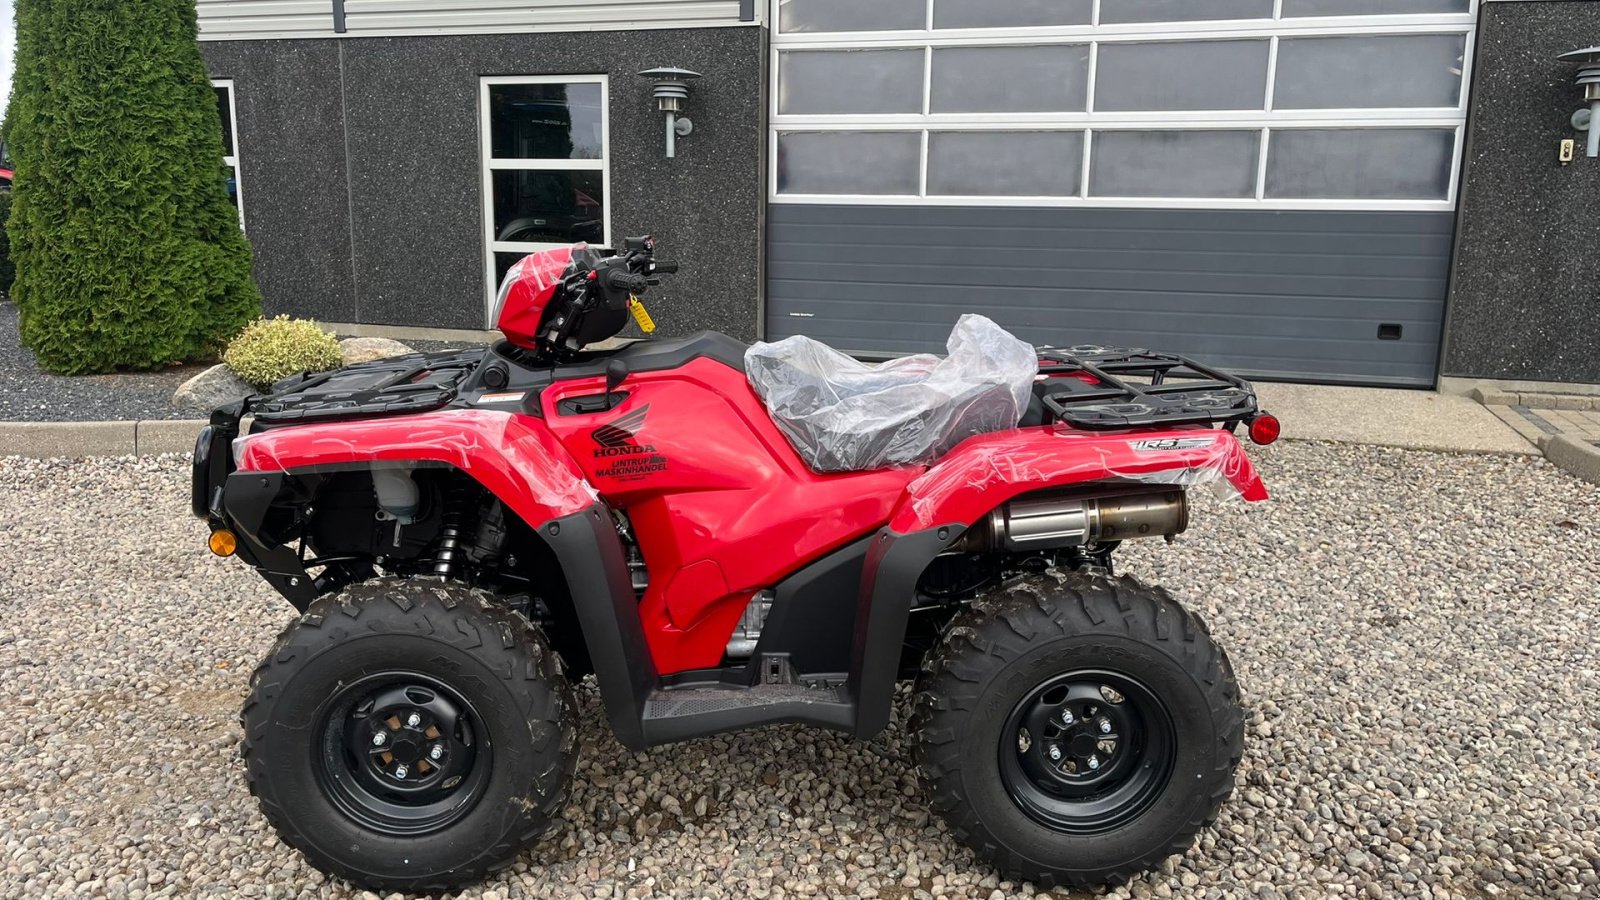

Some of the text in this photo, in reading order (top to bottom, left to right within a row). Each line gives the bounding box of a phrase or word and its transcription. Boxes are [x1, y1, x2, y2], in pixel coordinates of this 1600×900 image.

[594, 444, 656, 457] HONDA
[612, 456, 650, 468] LINTRUP
[596, 463, 667, 477] MASKINHANDEL
